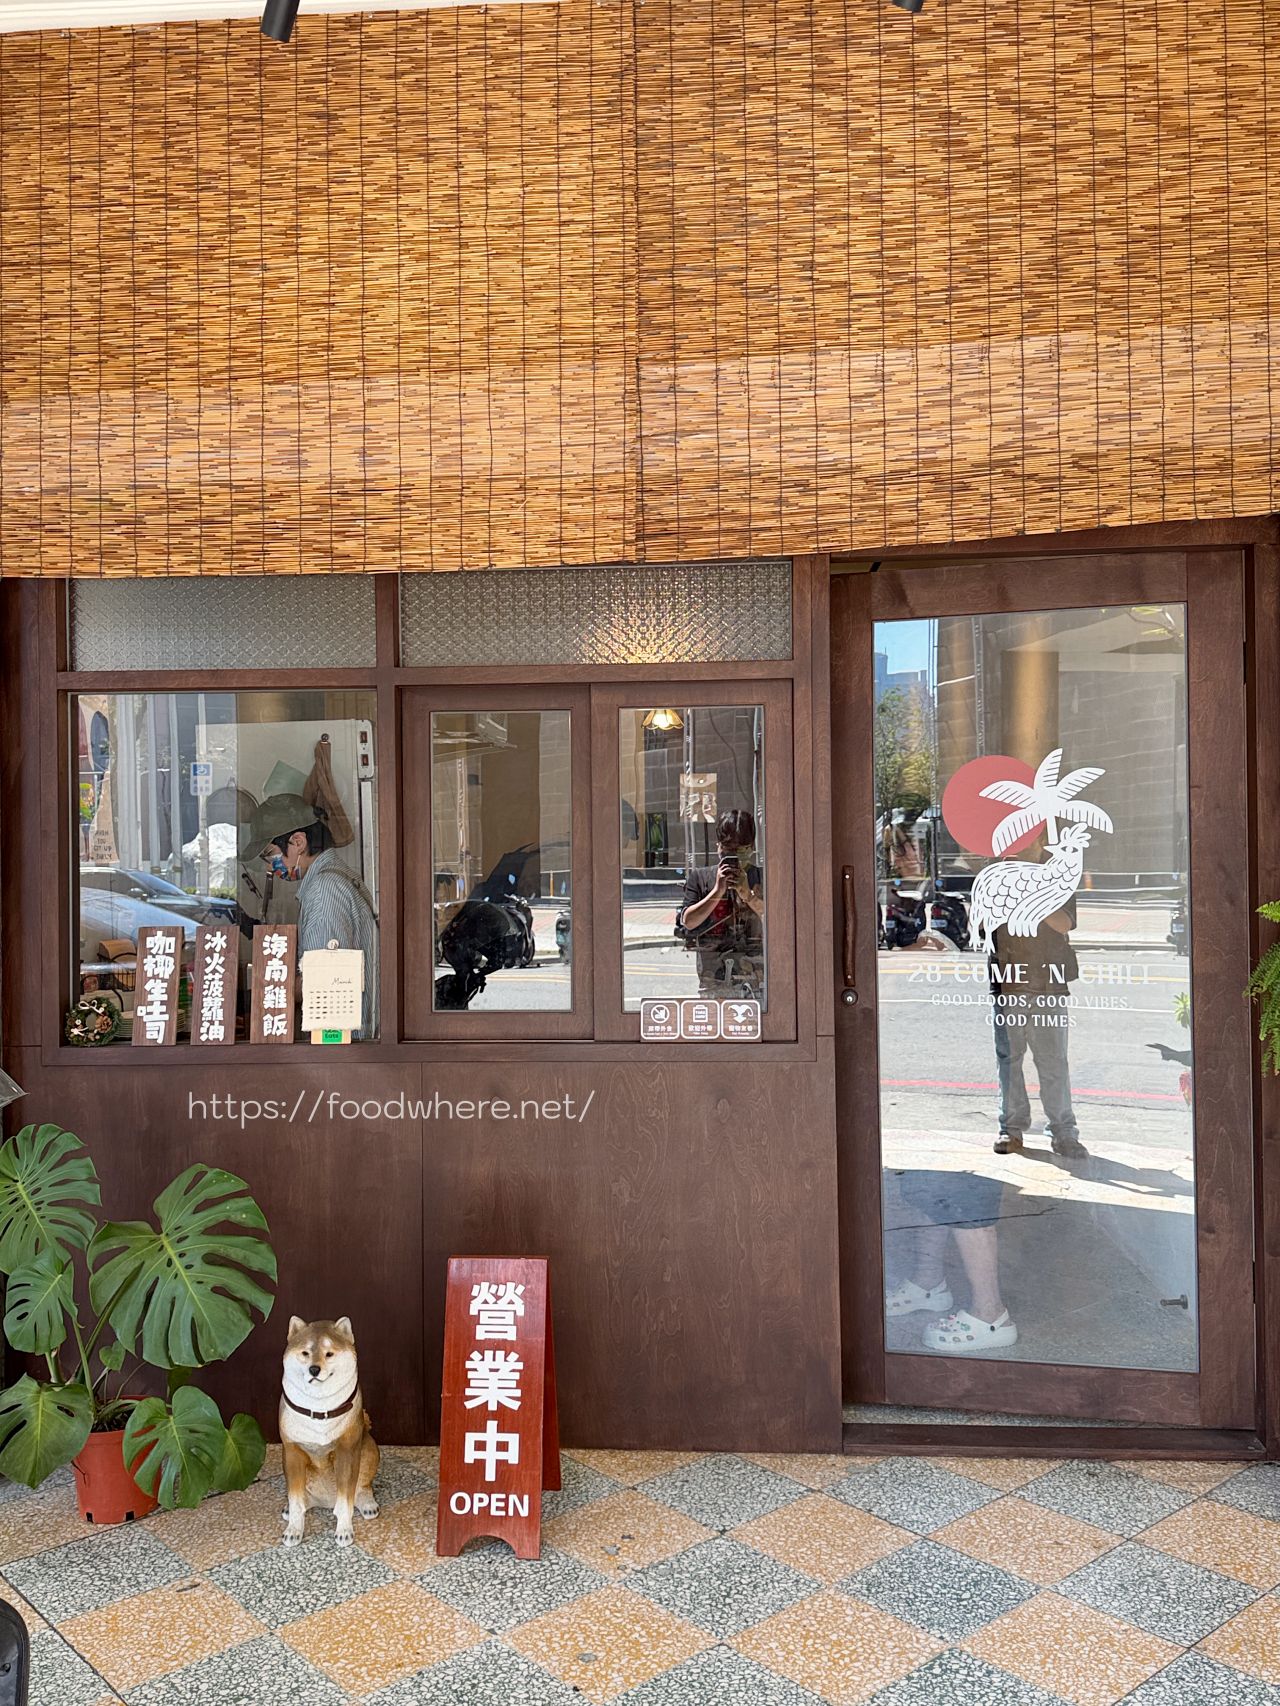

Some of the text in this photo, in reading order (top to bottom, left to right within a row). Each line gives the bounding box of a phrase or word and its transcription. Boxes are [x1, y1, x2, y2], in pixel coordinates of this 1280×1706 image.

[136, 930, 176, 1044] 咖椰生吐司
[199, 931, 228, 1042] 冰火菠蘿油
[262, 933, 288, 1037] 海南雞飯
[907, 963, 943, 984] 28
[953, 962, 1029, 985] COME
[1078, 962, 1158, 985] CHILL
[931, 993, 973, 1006] GOOD
[977, 994, 1033, 1008] FOODS,
[1036, 994, 1079, 1007] GOOD
[985, 1014, 1077, 1028] GOOD TIMES
[463, 1281, 527, 1482] 營業中
[449, 1491, 529, 1518] OPEN
